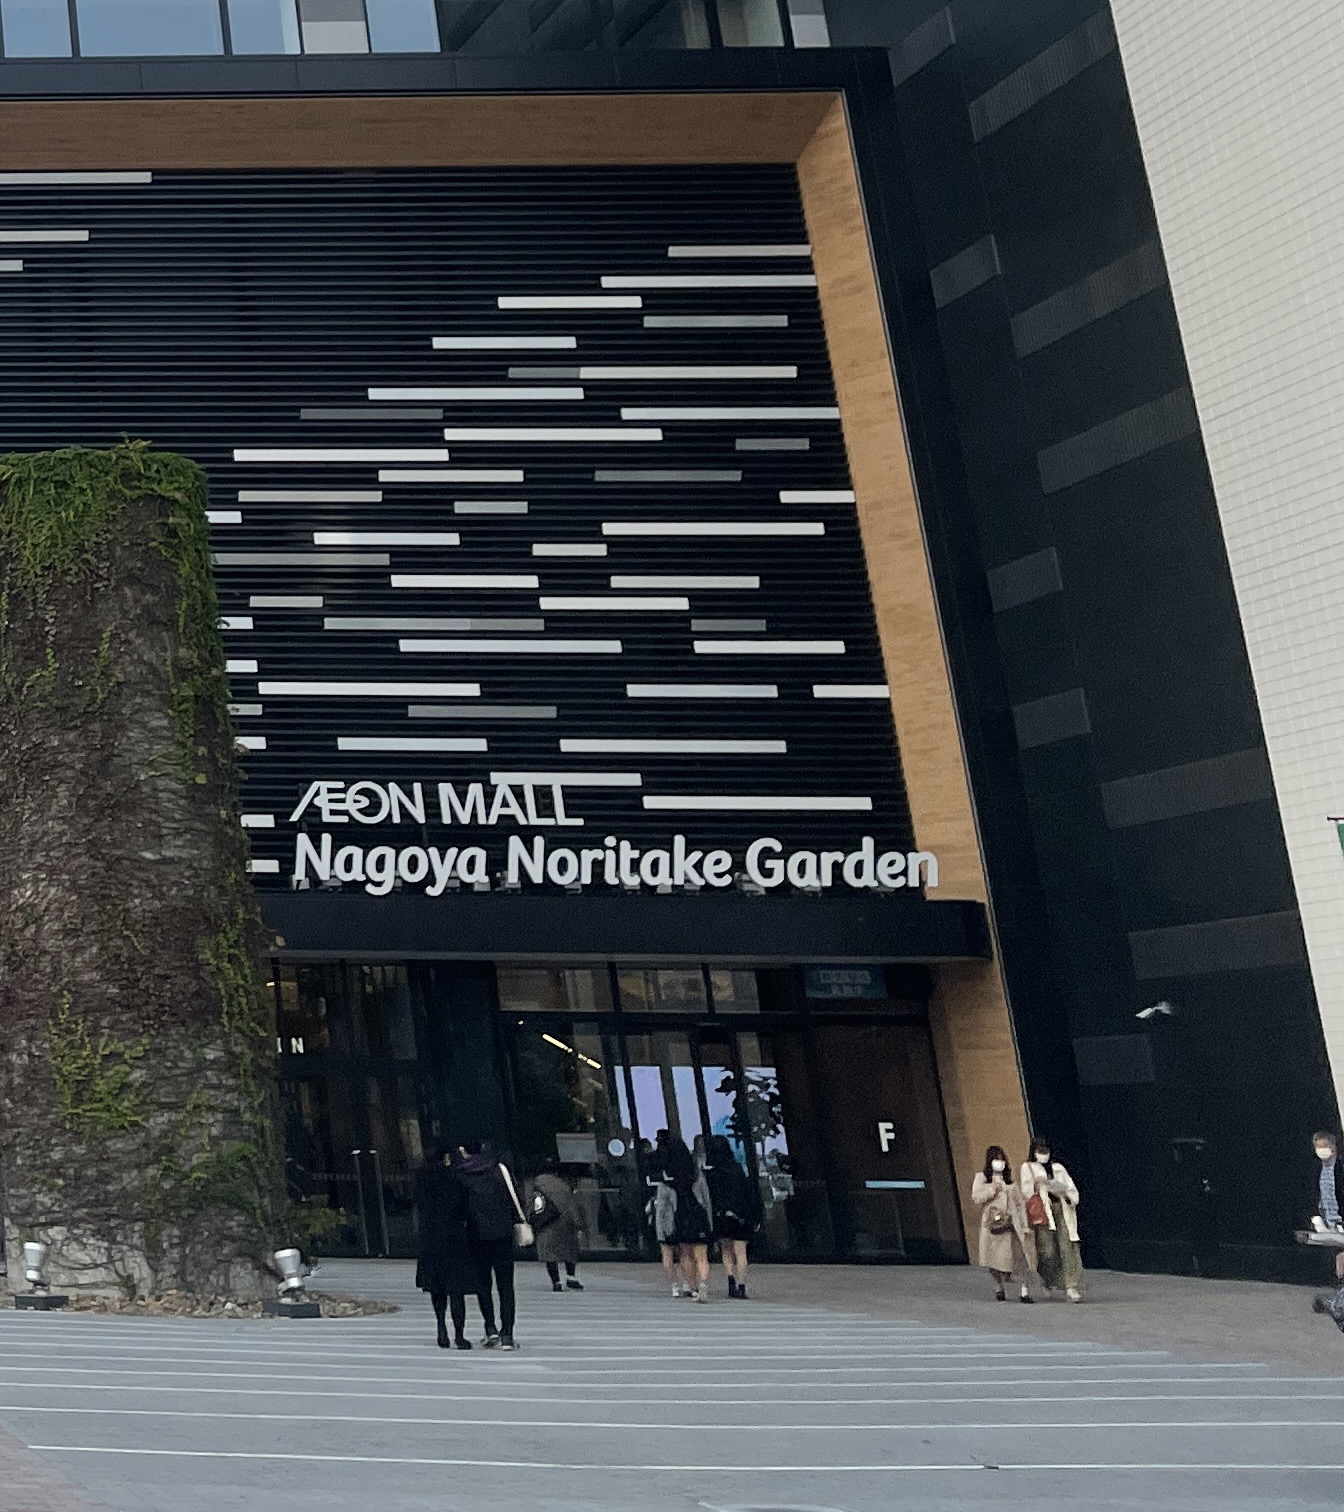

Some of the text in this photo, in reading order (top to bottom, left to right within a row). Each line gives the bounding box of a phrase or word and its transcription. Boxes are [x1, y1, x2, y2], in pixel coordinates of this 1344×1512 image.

[437, 782, 585, 826] MALL
[294, 832, 939, 896] Nagoya Noritake Garden
[878, 1122, 896, 1153] F
